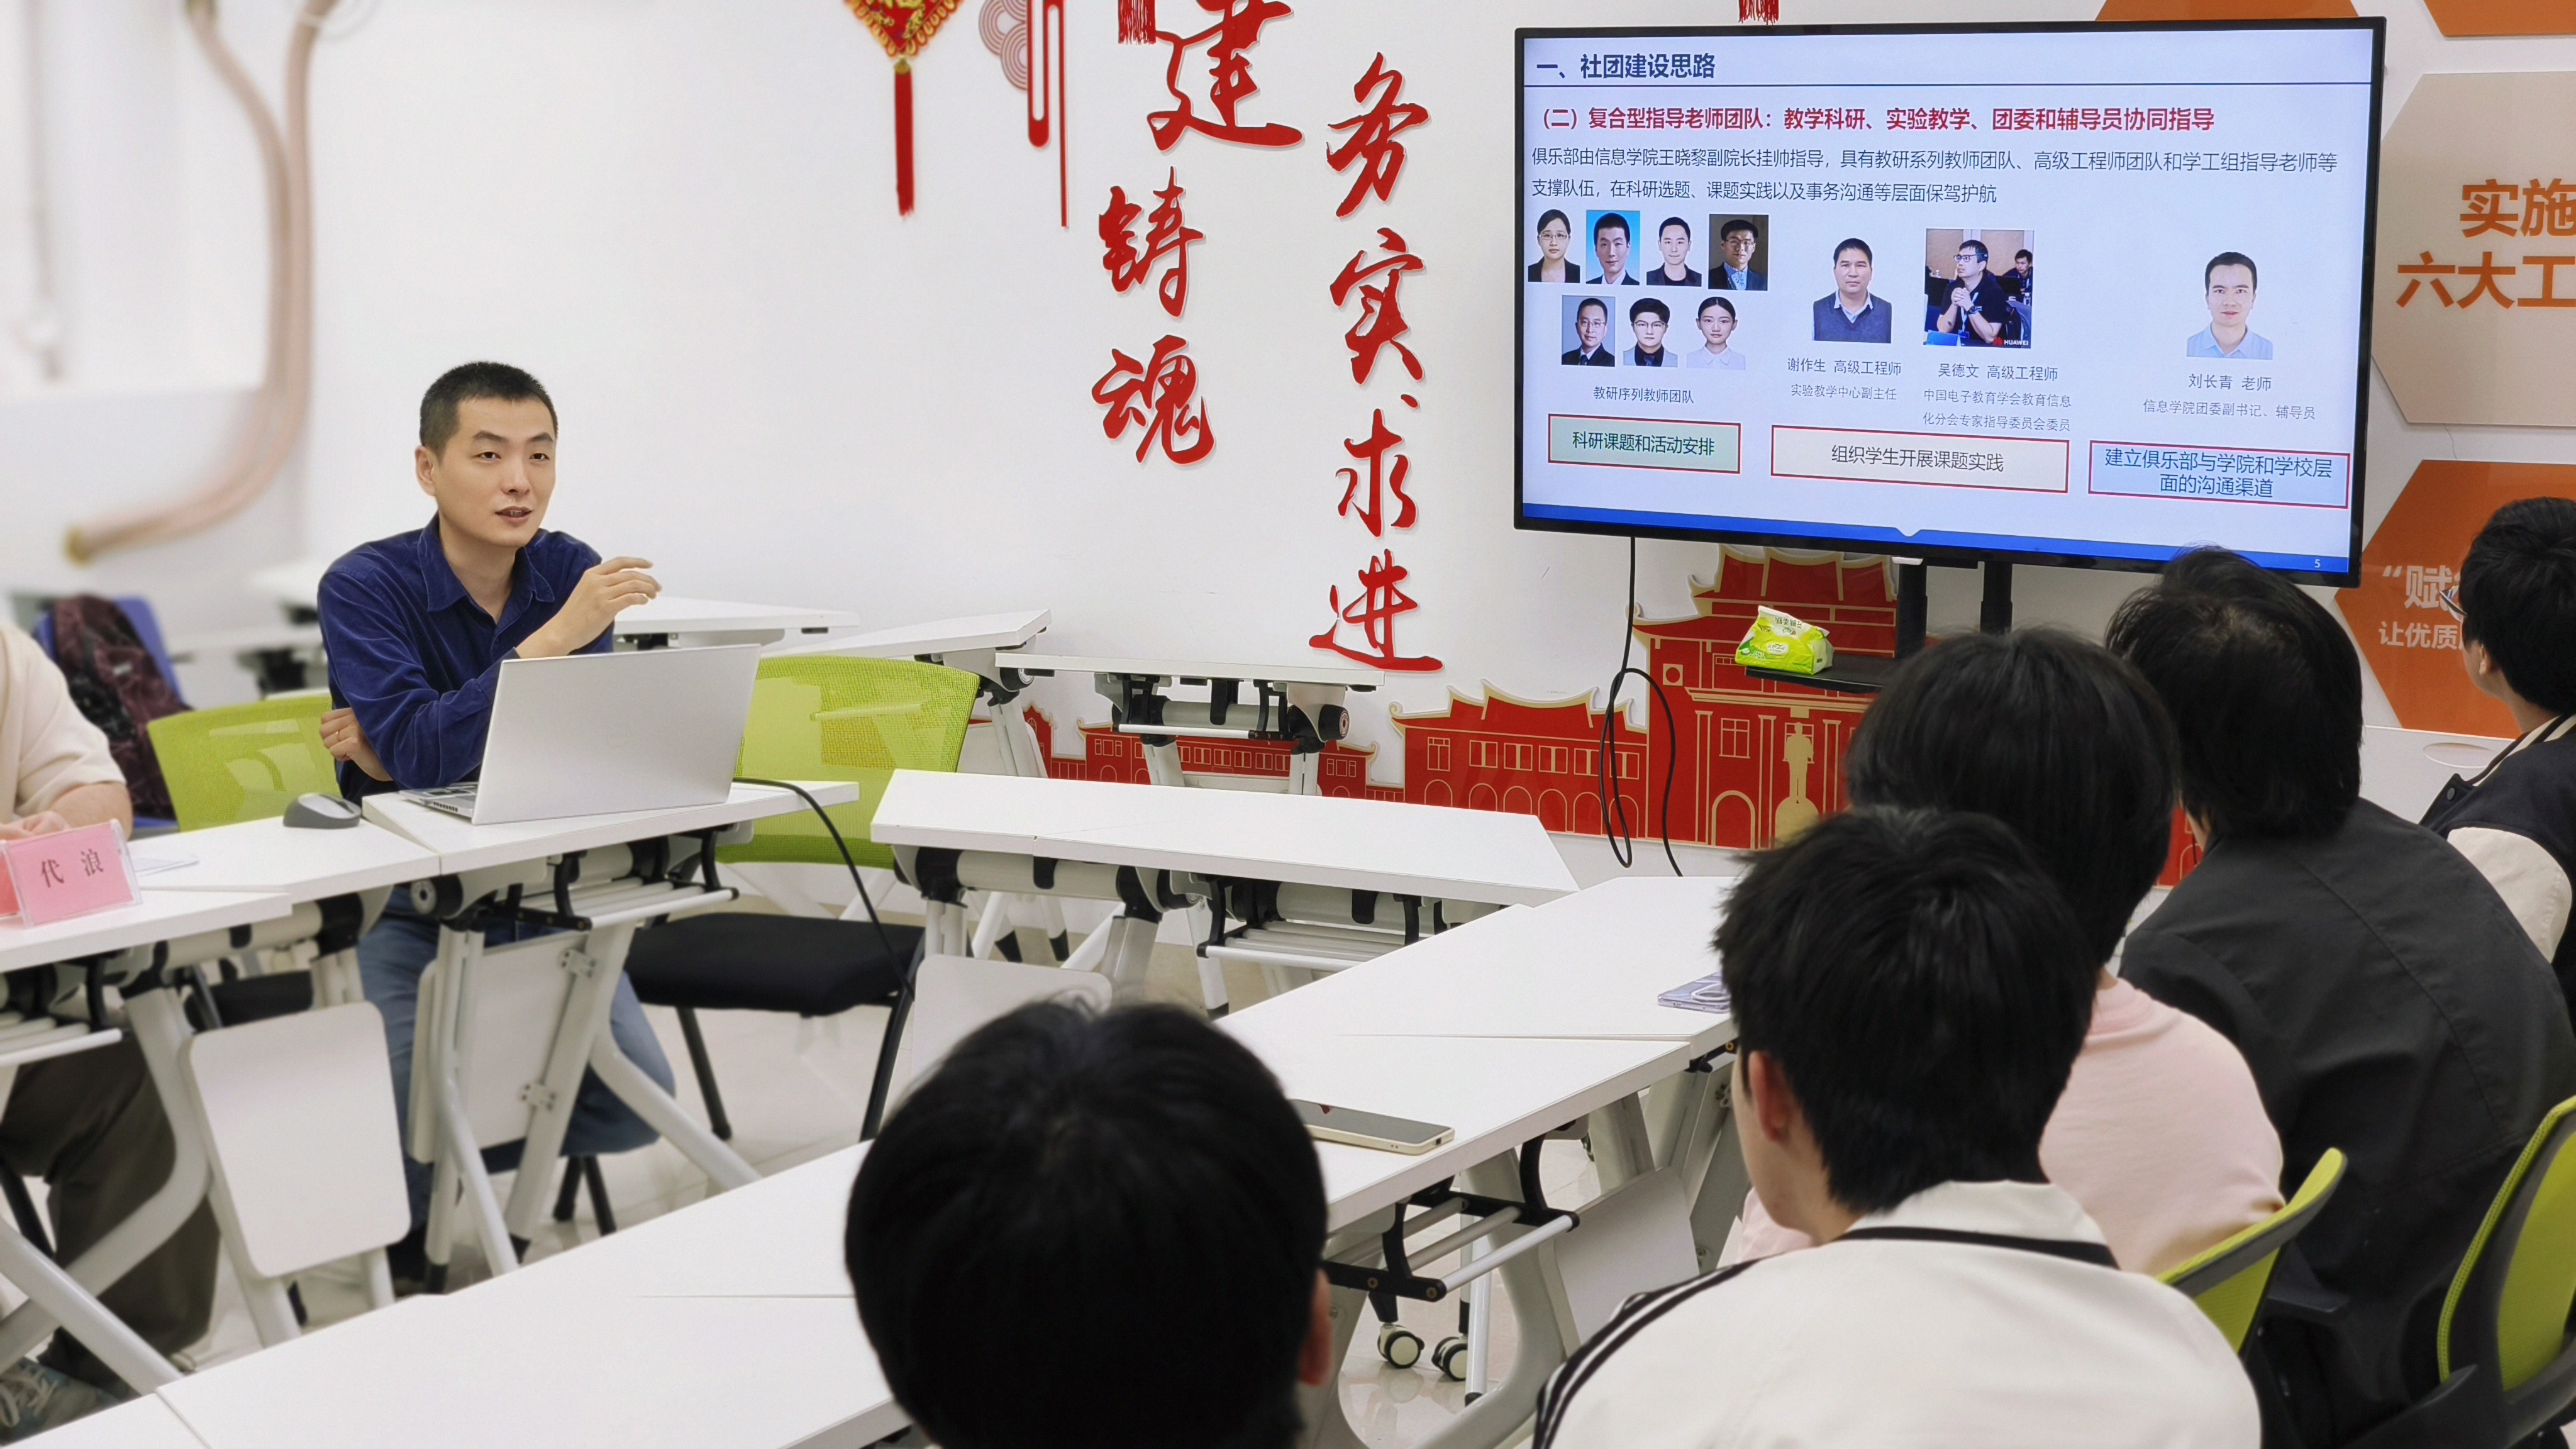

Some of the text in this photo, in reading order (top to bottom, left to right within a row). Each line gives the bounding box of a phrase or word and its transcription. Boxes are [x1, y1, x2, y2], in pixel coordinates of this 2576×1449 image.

[1537, 53, 1715, 79] 一、社团建设思路
[1544, 108, 2214, 131] （二）复合型指导老师团队：教学科研、实验教学、团委和辅导员协同指导
[1532, 148, 2337, 172] 俱乐部由信息学院王晓黎副院长挂帅指导，具有教研系列教师团队、高级工程师团队和学工组指导老师等
[1532, 179, 1996, 203] 支撑队伍，在科研选题、课题实践以及事务沟通等层面保驾护航
[2460, 179, 2576, 238] 实施
[2396, 250, 2576, 309] 六大工
[1309, 52, 1444, 674] 务实求进
[1788, 358, 1901, 375] 谢作生 高级工程师
[1939, 364, 2058, 381] 吴德文 高级工程师
[1594, 386, 1694, 403] 教研序列教师团队
[1792, 384, 1896, 400] 实验教学中心副主任
[2189, 374, 2271, 391] 刘长青 老师
[1924, 389, 2071, 407] 中国电子教育学会教育信息
[2143, 399, 2314, 419] 信息学院团委副书记、辅导员
[1923, 412, 2069, 432] 化分会专家指导委员会委员
[1573, 431, 1714, 455] 科研课题和活动安排
[1831, 445, 2004, 473] 组织学生开展课题实践
[2105, 448, 2332, 479] 建立俱乐部与学院和学校层
[2160, 474, 2273, 498] 面的沟通渠道
[2314, 558, 2320, 568] 5
[2382, 565, 2460, 610] “赋
[2378, 621, 2463, 650] 让优质
